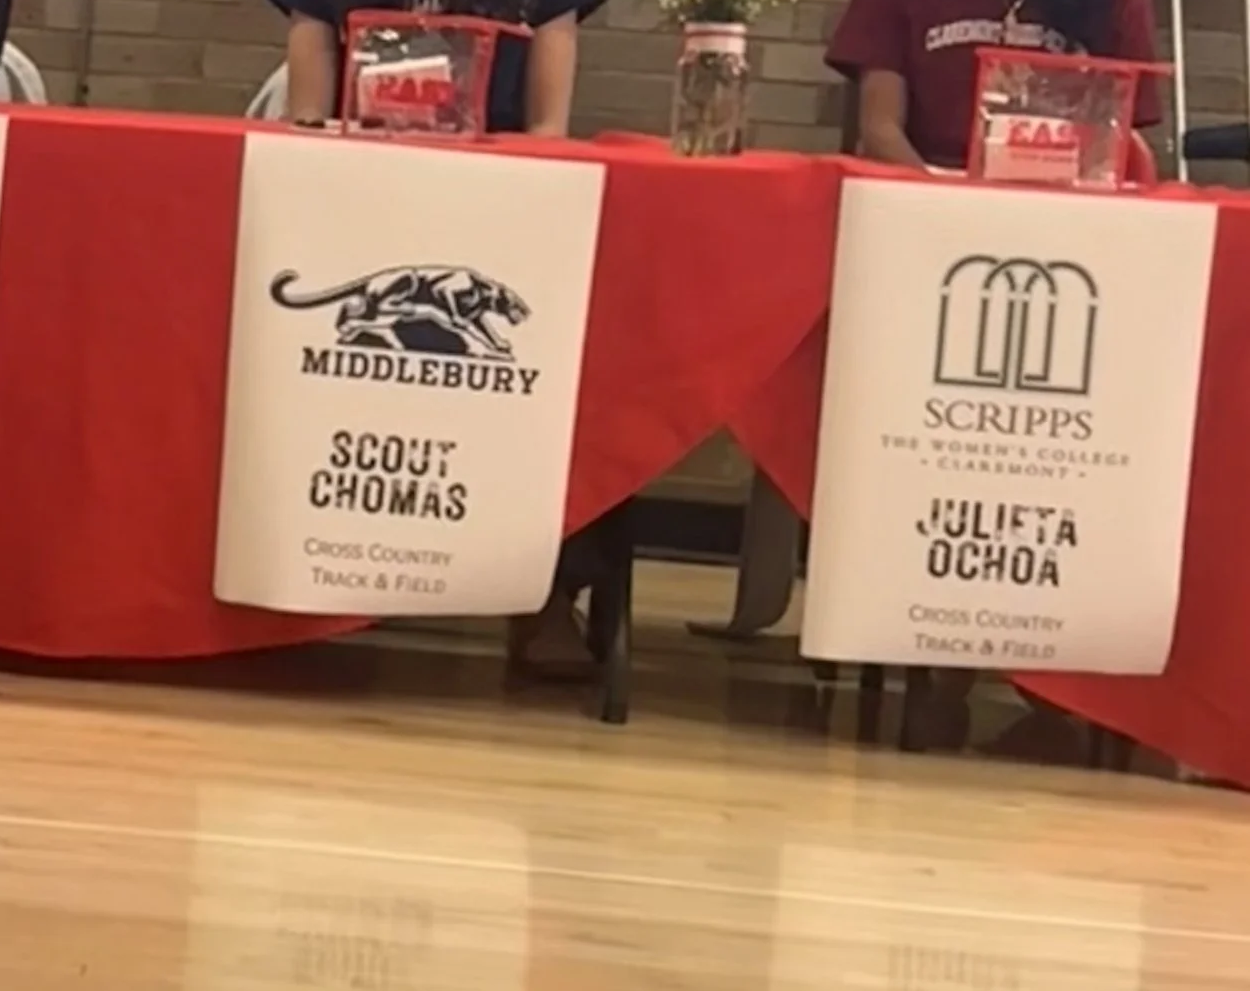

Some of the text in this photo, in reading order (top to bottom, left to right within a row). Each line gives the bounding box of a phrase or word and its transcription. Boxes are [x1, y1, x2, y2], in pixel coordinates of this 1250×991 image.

[301, 346, 540, 395] MIDDLEBURY
[923, 397, 1093, 441] SCRIPPS
[329, 429, 458, 478] SCOUT
[880, 434, 1130, 467] THE WOMEN'S COLLEGE
[936, 456, 1070, 479] CLAREMONT
[309, 469, 468, 521] CHOMAS
[915, 497, 1077, 547] JULIETA
[374, 572, 388, 591] &
[927, 538, 1060, 587] OCHOA
[979, 639, 994, 656] &
